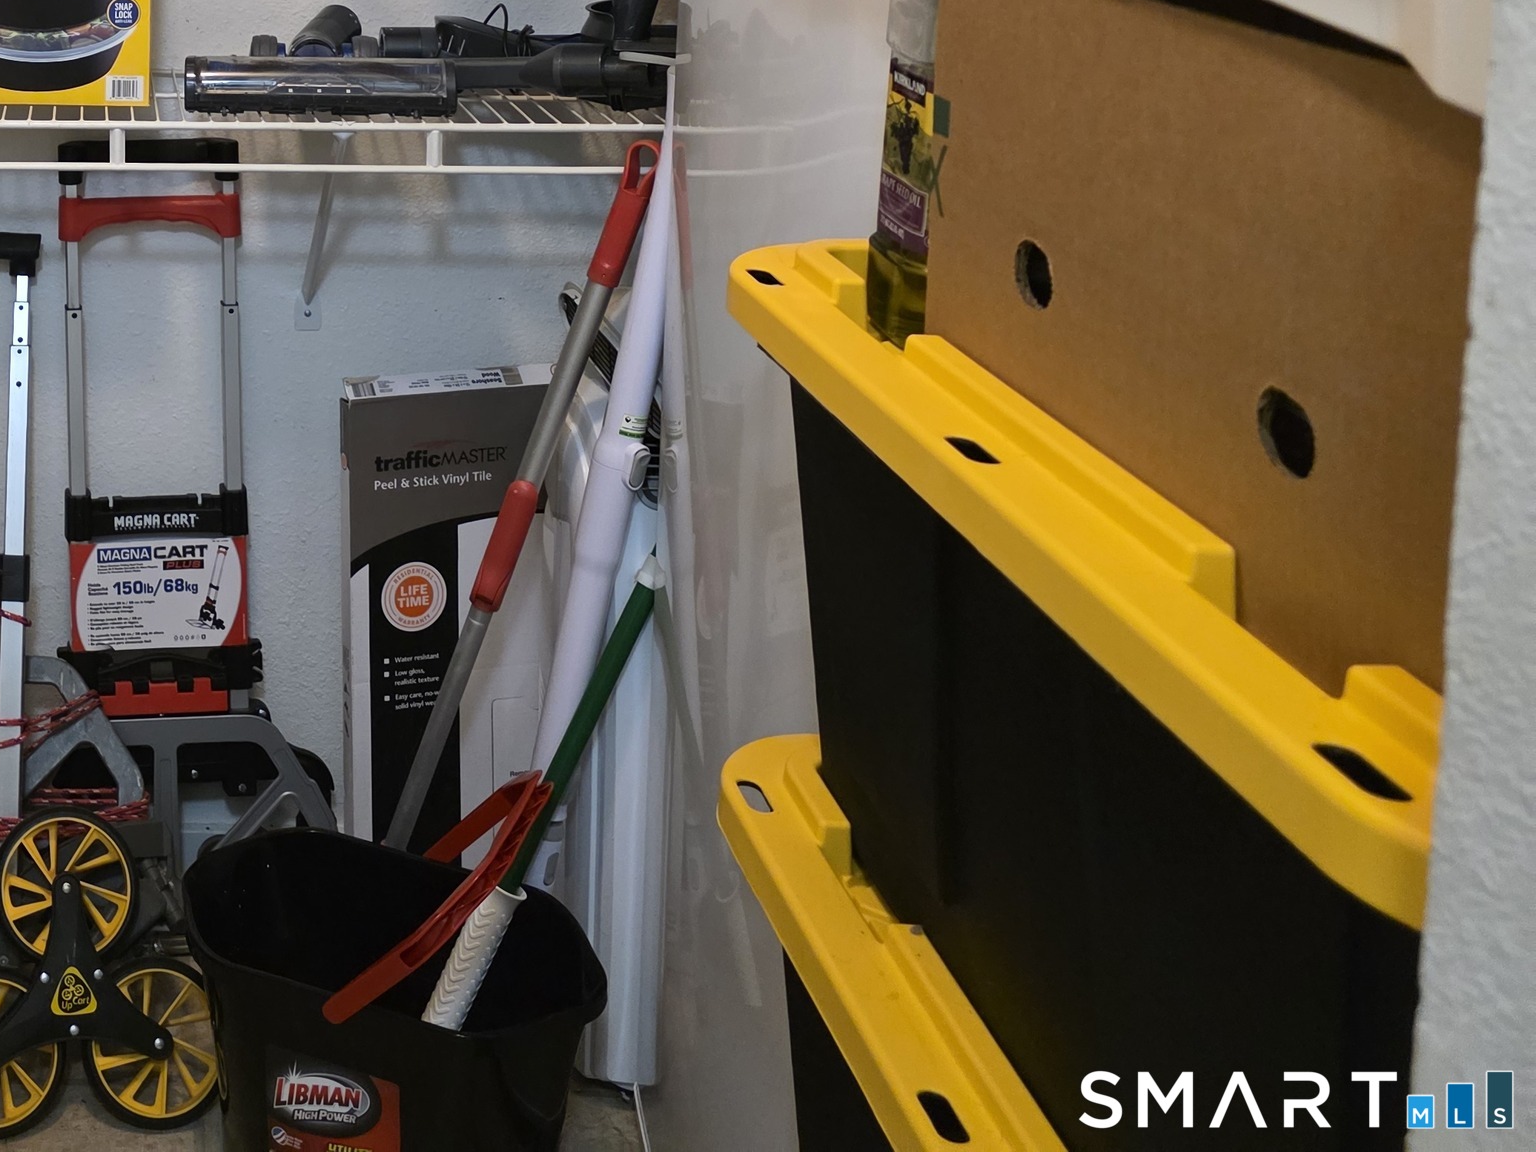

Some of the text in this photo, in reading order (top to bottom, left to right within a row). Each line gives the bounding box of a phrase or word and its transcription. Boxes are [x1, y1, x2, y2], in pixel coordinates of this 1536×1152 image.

[114, 3, 133, 11] SNAP
[114, 11, 133, 19] LOCK
[909, 191, 922, 209] OIL
[374, 447, 506, 472] trafficMASTER
[374, 470, 492, 491] Peel & Stick Vinyl Tile
[114, 514, 160, 528] MAGNA
[164, 513, 197, 526] CART
[100, 544, 208, 562] MAGNA CART
[166, 560, 201, 568] PLUS
[393, 568, 435, 585] RESIDENTIAL
[400, 583, 429, 597] LIFE
[397, 595, 430, 608] TIME
[397, 614, 432, 626] WARRANTY
[414, 653, 439, 661] resistant
[394, 678, 417, 686] realistic
[395, 693, 408, 701] Easy
[395, 702, 409, 710] solid
[409, 700, 424, 708] vinyl
[62, 996, 90, 1012] Up Cart
[273, 1076, 363, 1109] LIBMAN
[293, 1109, 357, 1124] HIGH POWER
